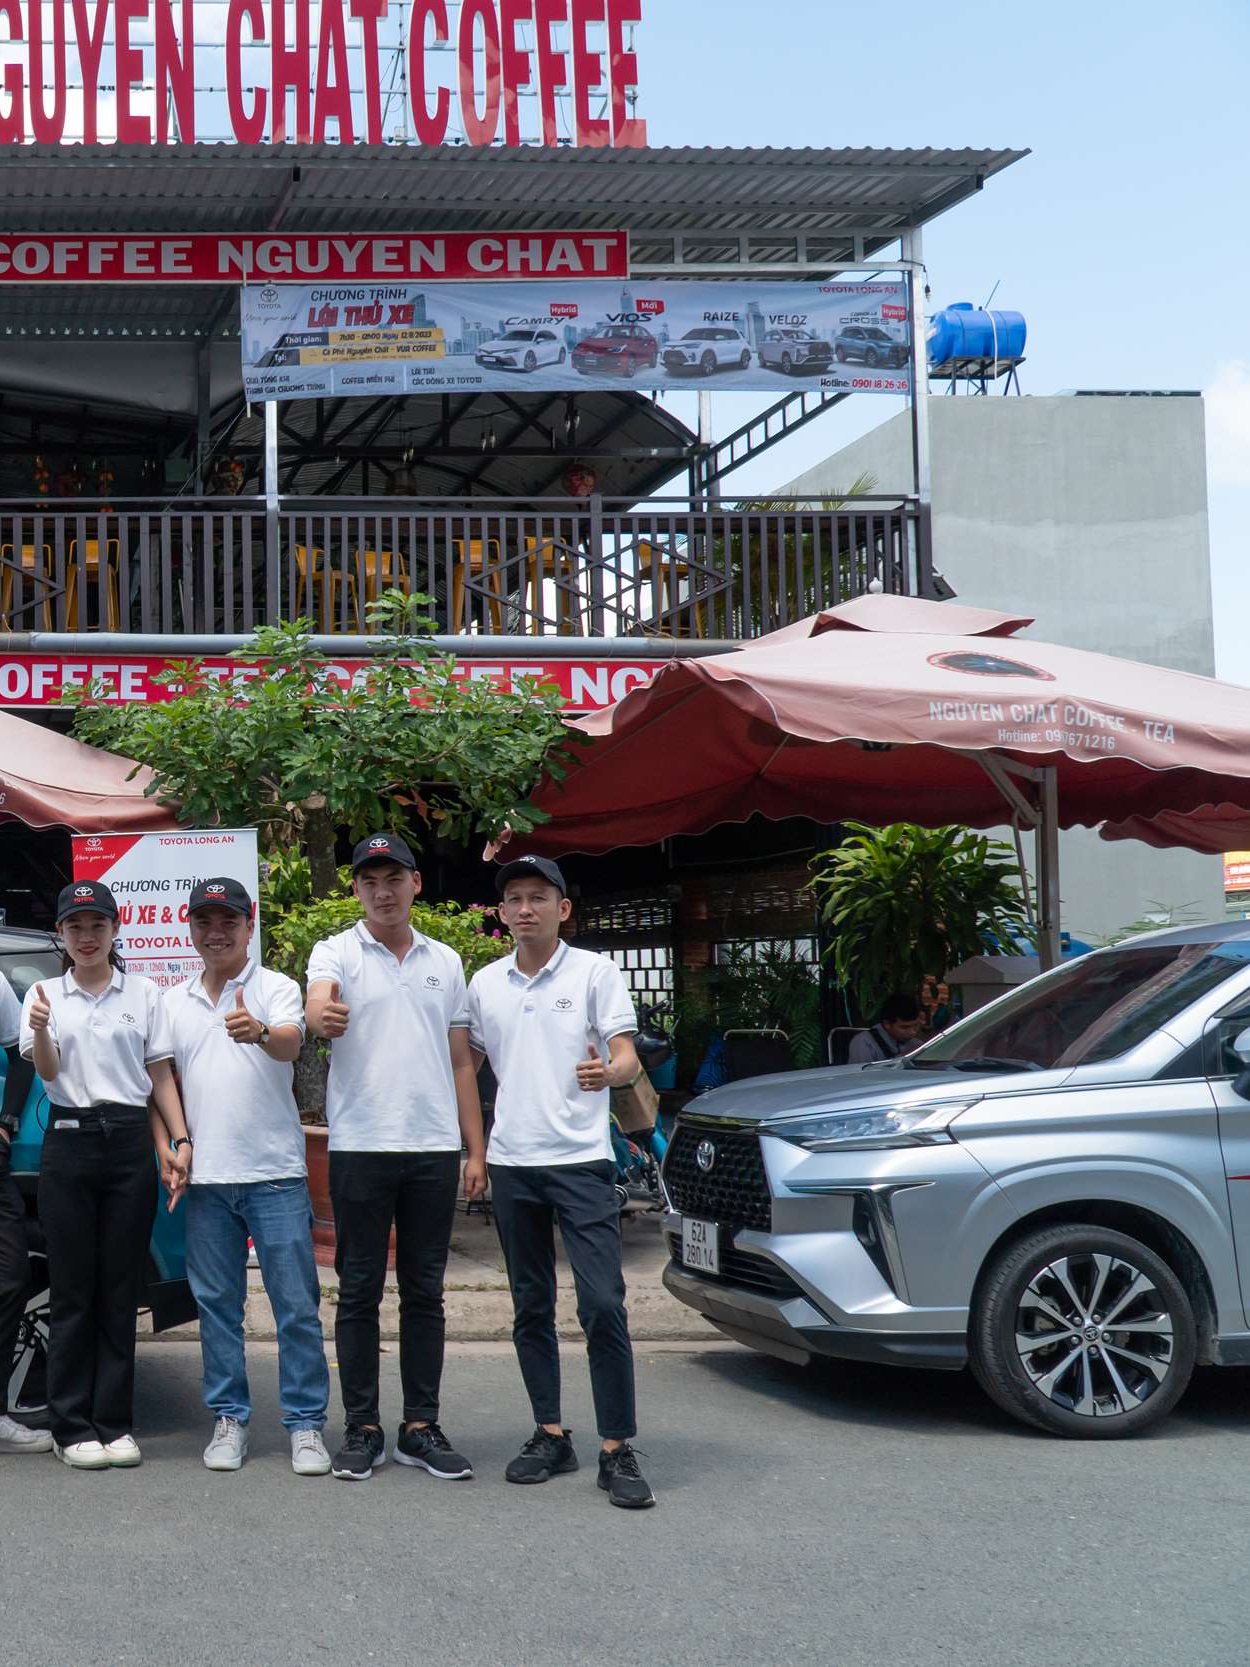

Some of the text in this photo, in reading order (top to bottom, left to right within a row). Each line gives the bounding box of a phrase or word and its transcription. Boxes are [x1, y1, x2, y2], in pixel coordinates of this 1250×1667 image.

[226, 0, 387, 145] CHAT
[410, 0, 647, 148] COFFEE
[218, 239, 447, 273] NGUYEN
[466, 237, 618, 272] CHAT
[311, 289, 365, 301] CHƯƠNG
[855, 286, 882, 294] LONG
[388, 303, 416, 325] XE
[551, 305, 577, 315] Hybrid
[882, 307, 906, 317] Hybrid
[505, 316, 566, 325] CAMRY
[606, 312, 654, 323] VIOS
[703, 312, 739, 322] RAIZE
[769, 314, 808, 325] VELOZ
[929, 701, 1005, 722] NGUYEN
[1010, 703, 1058, 725] CHAT
[1063, 705, 1127, 733] COFFEE
[1142, 719, 1177, 745] TEA
[998, 728, 1042, 743] Hotline:
[159, 835, 234, 846] TOYOTA LONG AN
[111, 878, 170, 893] CHƯƠNG
[136, 903, 157, 925] XE
[160, 904, 173, 924] &
[126, 935, 182, 949] TOYOTA
